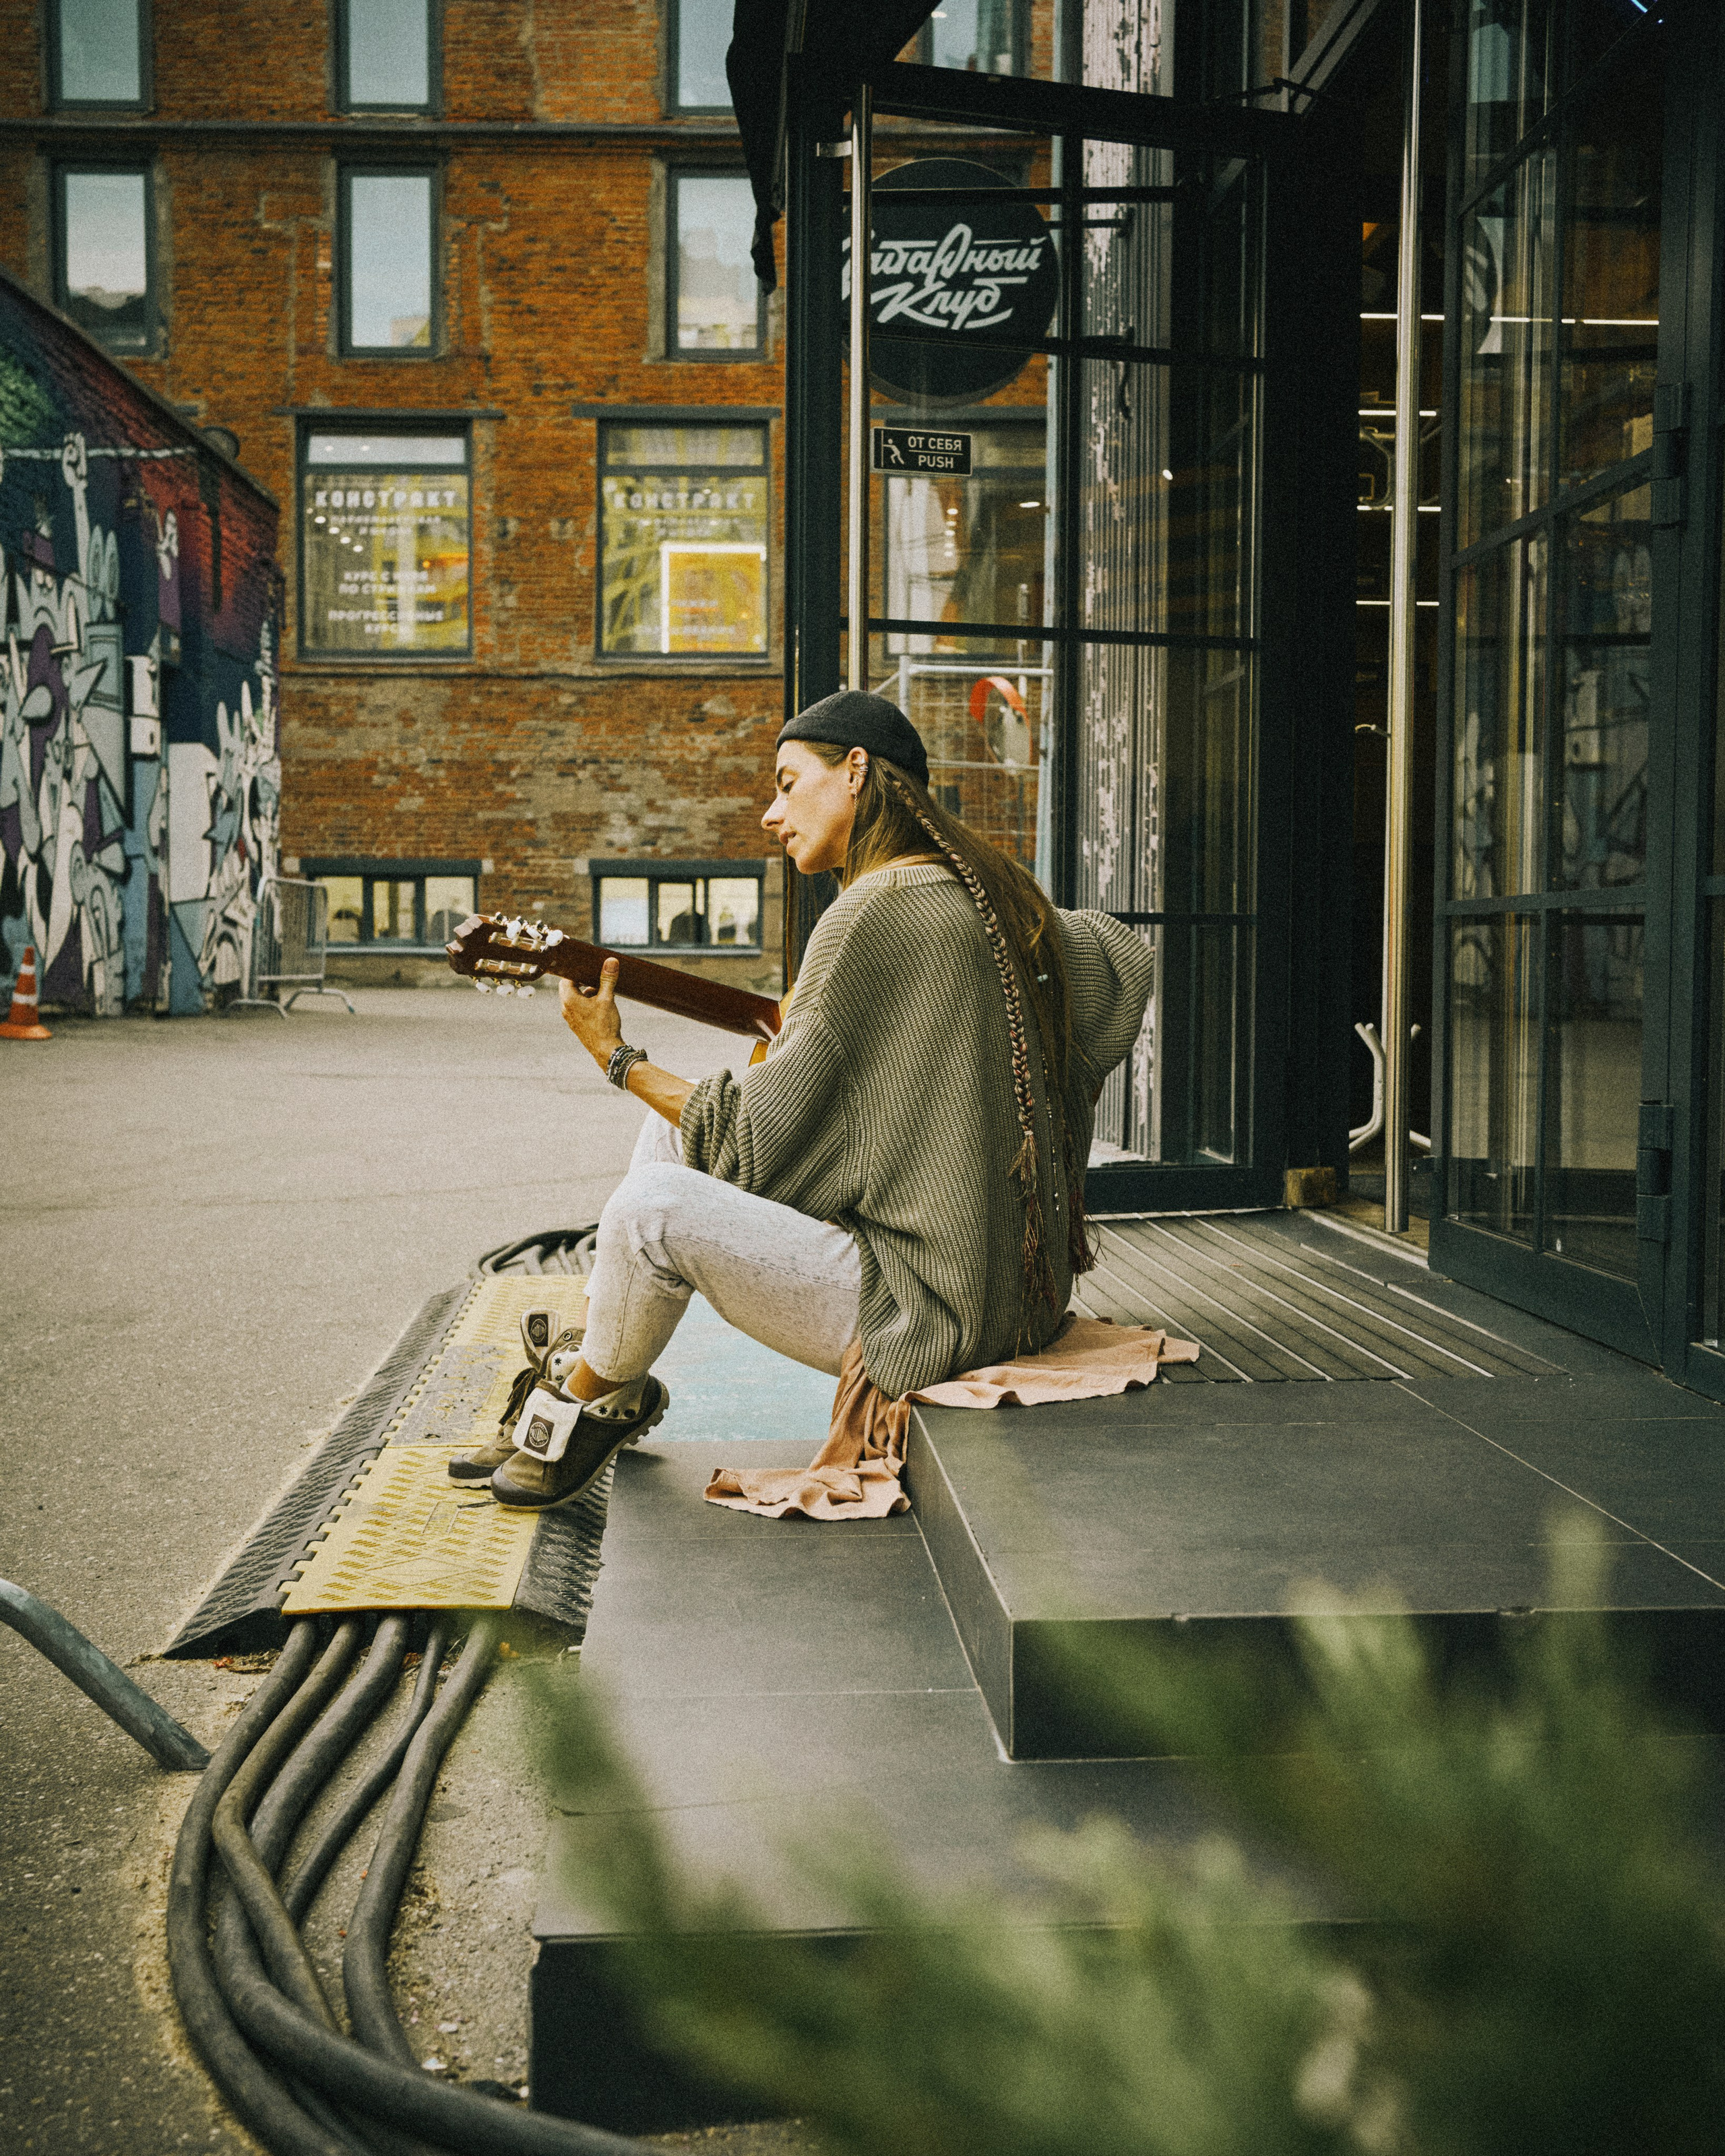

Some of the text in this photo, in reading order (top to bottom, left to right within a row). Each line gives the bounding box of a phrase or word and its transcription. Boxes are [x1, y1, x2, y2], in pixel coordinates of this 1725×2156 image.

[842, 224, 1047, 300] итарный
[871, 276, 1028, 330] Клуб
[908, 436, 962, 451] ОТ СЕБЯ
[918, 455, 954, 469] PUSH
